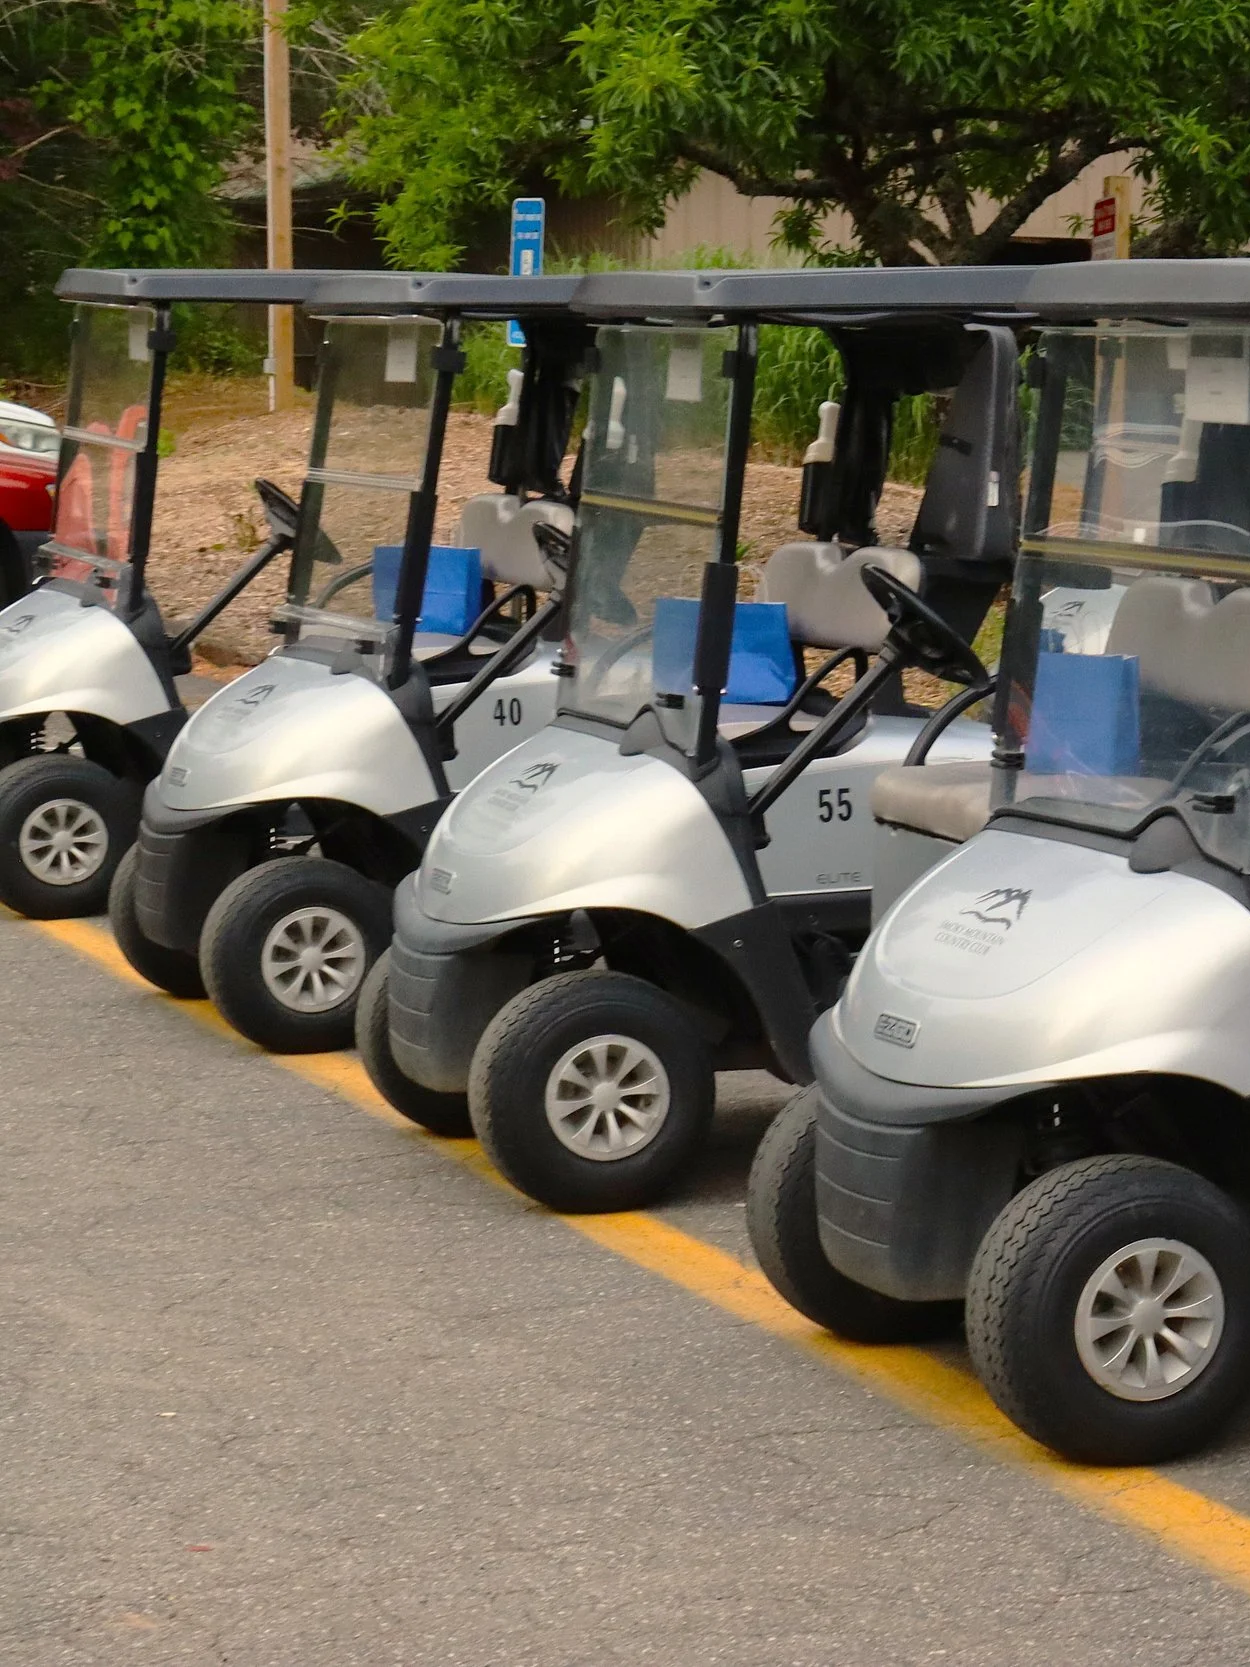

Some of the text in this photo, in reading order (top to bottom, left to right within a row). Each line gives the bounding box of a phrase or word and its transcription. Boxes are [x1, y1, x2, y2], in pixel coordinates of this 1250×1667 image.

[494, 697, 521, 727] 40
[819, 787, 853, 823] 55
[815, 870, 862, 885] ELITE
